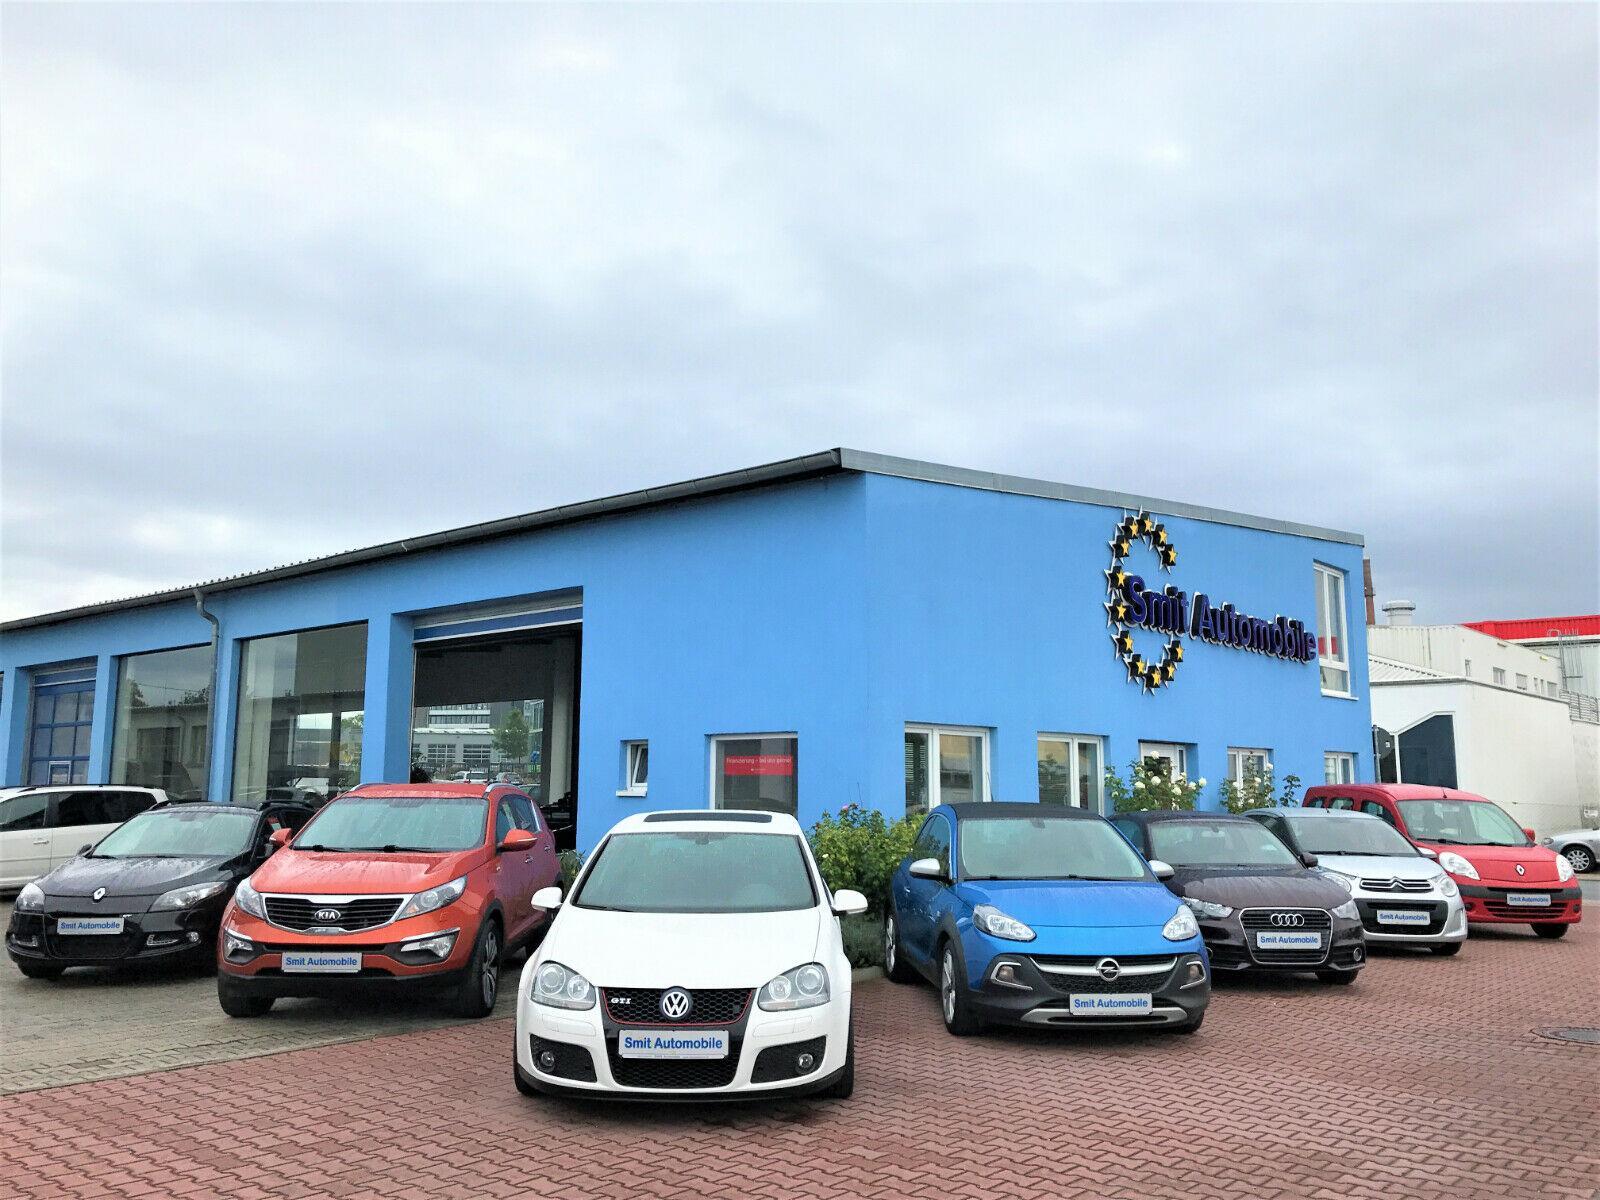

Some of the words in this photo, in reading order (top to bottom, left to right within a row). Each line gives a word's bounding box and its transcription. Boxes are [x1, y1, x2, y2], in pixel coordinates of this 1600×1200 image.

[1121, 574, 1189, 637] Smit
[1190, 592, 1317, 664] Automobile
[318, 911, 336, 920] KIA
[1394, 913, 1428, 921] Automobile
[77, 921, 120, 929] Automobile
[1278, 936, 1318, 944] Automobile
[285, 957, 306, 966] Smit
[307, 957, 358, 966] Automobile
[610, 997, 632, 1005] GTI
[1074, 998, 1095, 1008] Smit
[1097, 998, 1148, 1008] Automobile
[624, 1036, 652, 1049] Smit
[654, 1036, 723, 1049] Automobile
